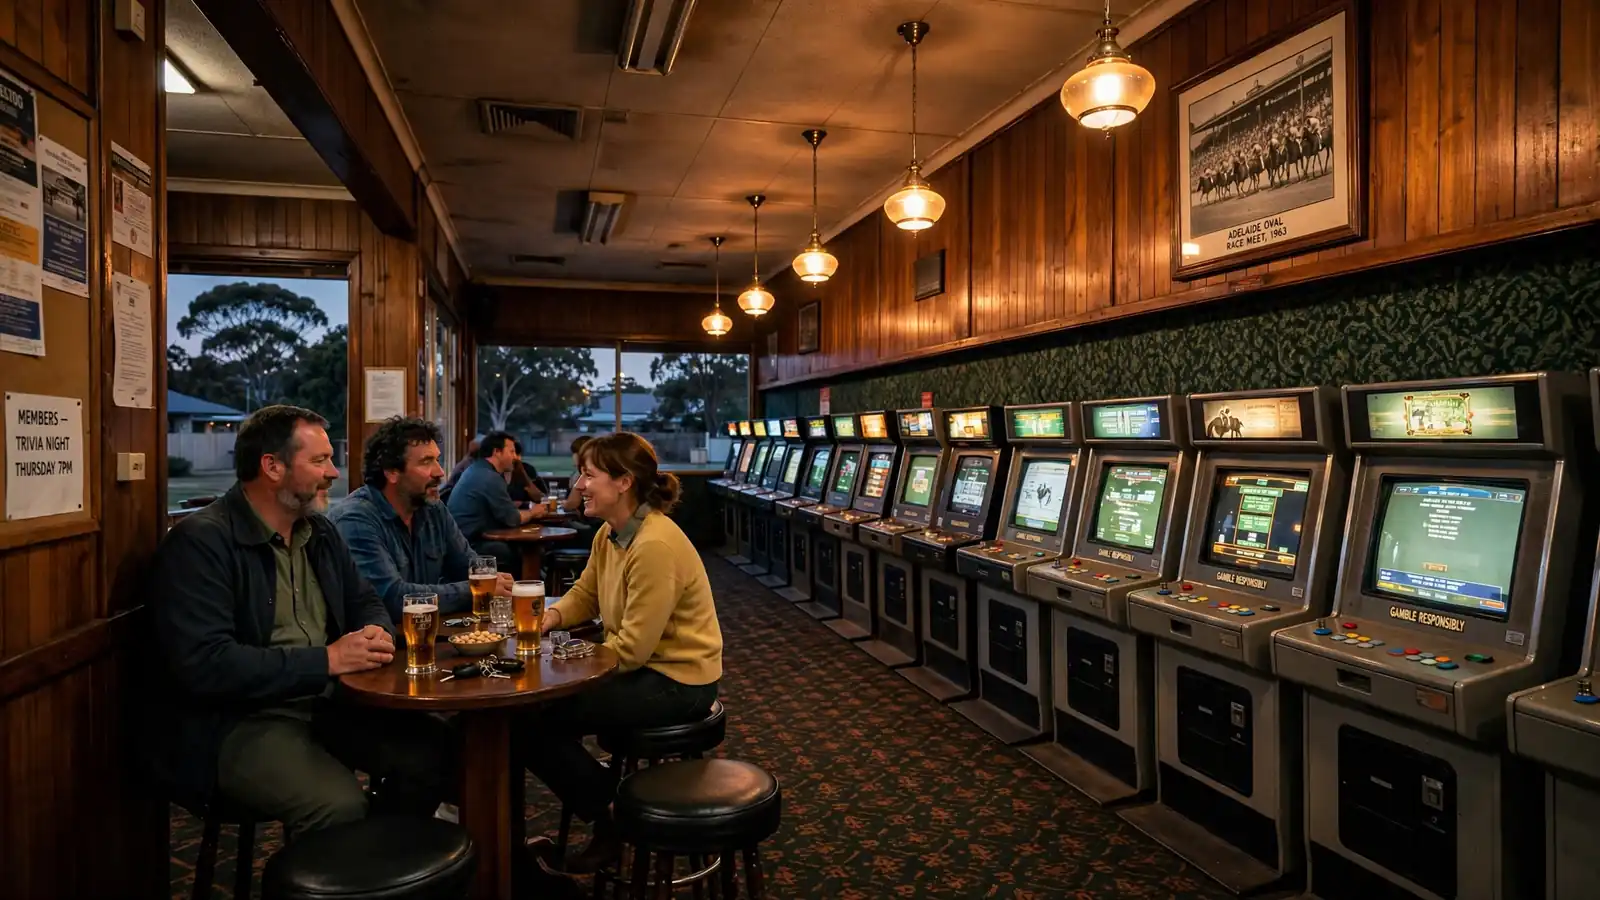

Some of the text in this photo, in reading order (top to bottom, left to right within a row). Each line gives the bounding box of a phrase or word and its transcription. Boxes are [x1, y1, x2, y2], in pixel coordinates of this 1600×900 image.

[1226, 226, 1287, 250] RACE MEET, 1963
[1228, 217, 1284, 240] ADELAIDE OVAL
[18, 409, 59, 426] MEMBERS
[15, 436, 70, 451] TRIVIA NIGHT
[15, 461, 73, 476] THURSDAY 7PM
[1390, 606, 1466, 632] GAMBLE RESPONSIBLY
